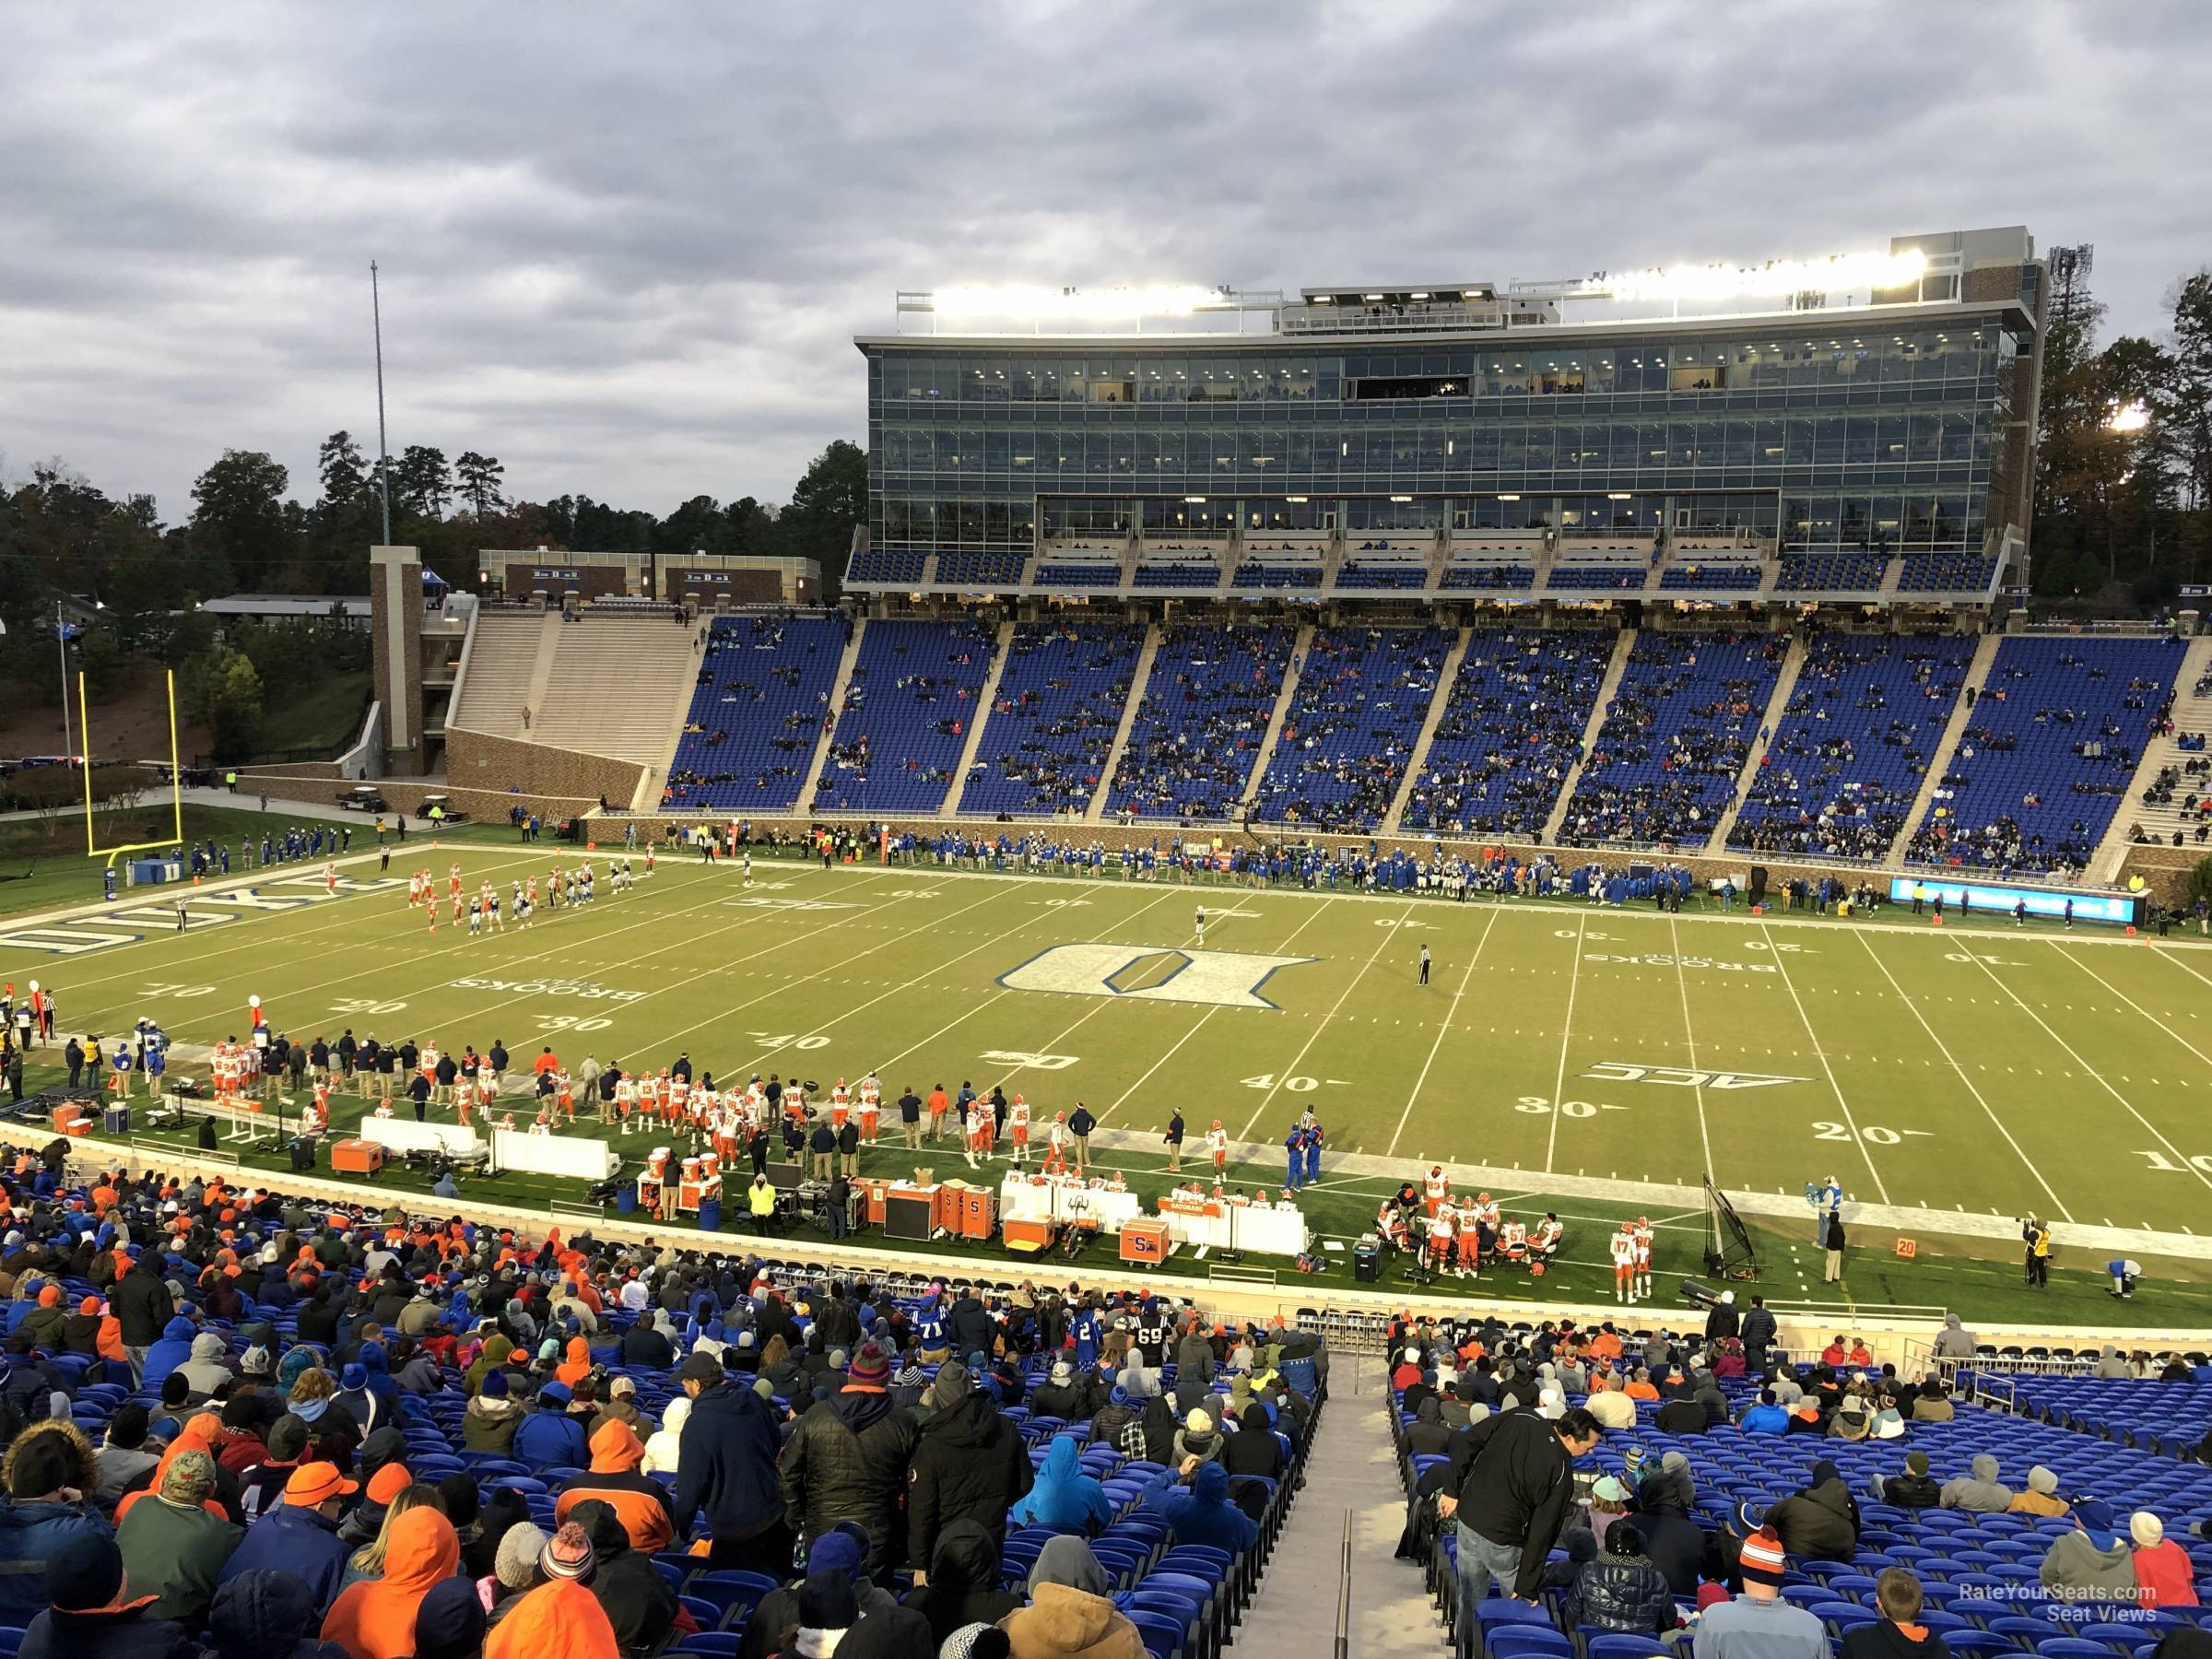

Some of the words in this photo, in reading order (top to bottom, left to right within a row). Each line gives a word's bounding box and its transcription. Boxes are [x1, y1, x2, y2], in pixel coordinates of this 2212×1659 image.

[891, 889, 942, 899] 30
[0, 873, 418, 956] DUKE
[1554, 930, 1608, 940] 30
[1744, 941, 1801, 952] 20
[1583, 954, 1779, 972] BROOKS
[136, 983, 217, 997] 10
[450, 979, 648, 1001] BROOKS
[327, 999, 407, 1014] 20
[536, 1016, 613, 1031] 30
[754, 1034, 831, 1050] 40
[1574, 1062, 1818, 1089] ACC
[641, 1085, 652, 1094] 13
[1239, 1074, 1320, 1092] 40
[674, 1088, 685, 1098] 30
[786, 1092, 799, 1101] 78
[865, 1094, 877, 1104] 45
[1514, 1096, 1597, 1118] 30
[1017, 1110, 1028, 1121] 85
[1812, 1121, 1901, 1145] 20
[971, 1200, 979, 1212] S
[1171, 1202, 1204, 1213] GATORADE
[1463, 1216, 1476, 1227] 51
[1510, 1229, 1524, 1241] 57
[1134, 1235, 1147, 1252] S
[1616, 1241, 1629, 1253] 17
[1899, 1240, 1914, 1253] 20
[920, 1321, 943, 1339] 71
[1079, 1322, 1091, 1340] 2
[1138, 1327, 1162, 1345] 69
